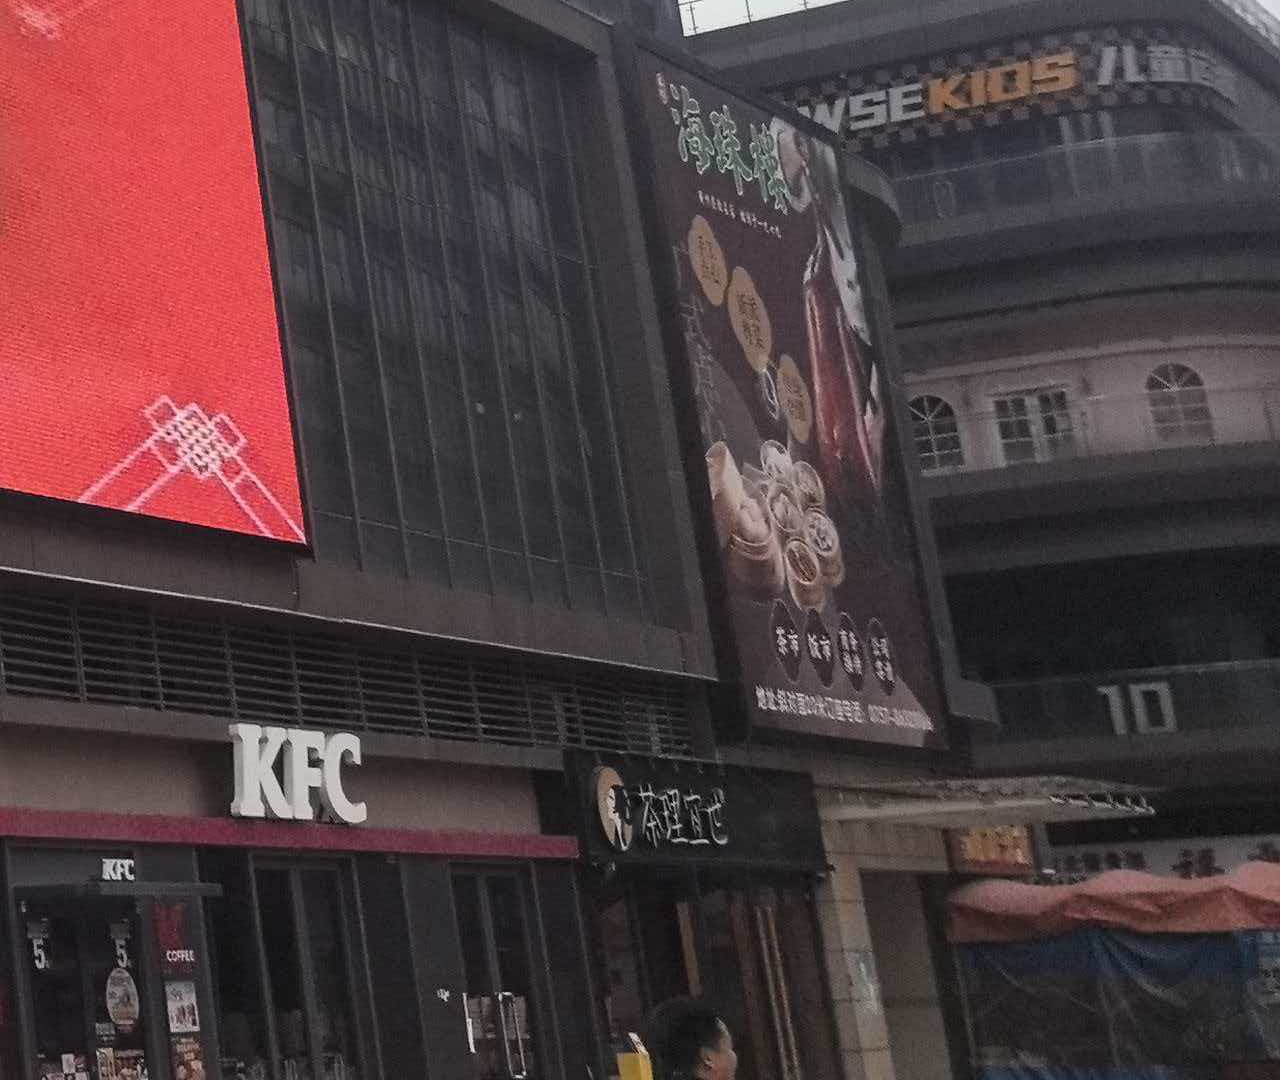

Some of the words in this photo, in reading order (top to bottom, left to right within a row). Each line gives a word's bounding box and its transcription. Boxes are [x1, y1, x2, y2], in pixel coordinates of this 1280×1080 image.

[1096, 682, 1178, 736] 10
[228, 723, 368, 824] KFC
[638, 783, 729, 848] 茶理宜世
[101, 858, 135, 881] KFC
[166, 949, 196, 962] COFFEE
